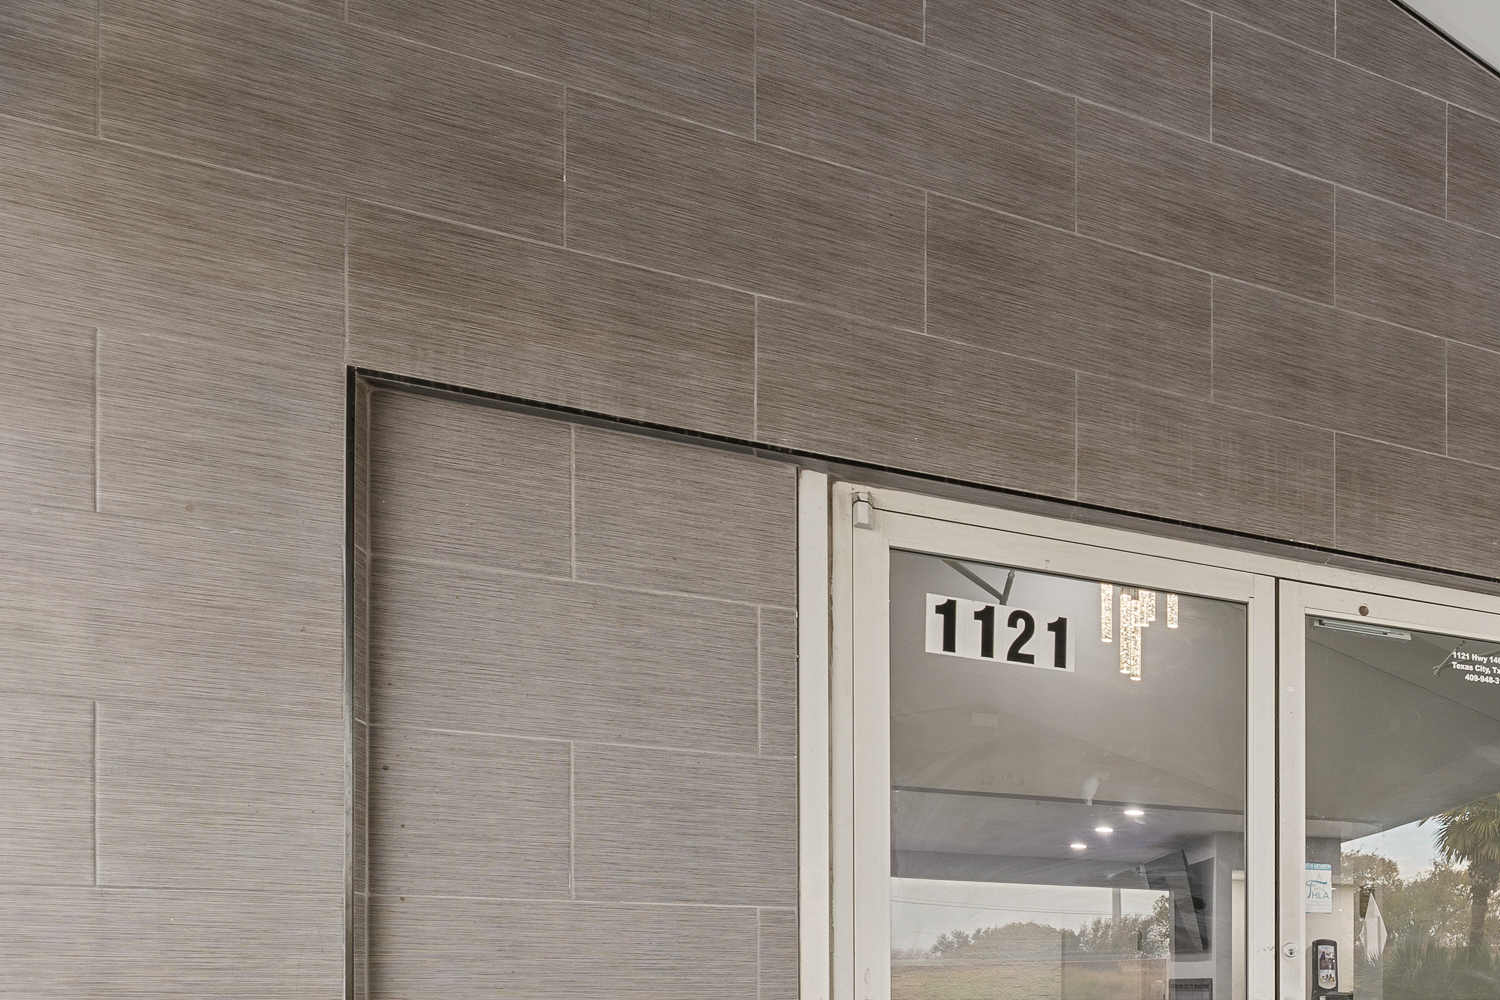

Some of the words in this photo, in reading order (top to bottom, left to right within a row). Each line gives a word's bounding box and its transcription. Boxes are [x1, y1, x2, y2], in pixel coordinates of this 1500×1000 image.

[935, 599, 1067, 669] 1121
[1452, 651, 1470, 660] 1121
[1471, 653, 1488, 664] Hwy
[1451, 661, 1473, 671] Texas
[1475, 665, 1491, 674] City,
